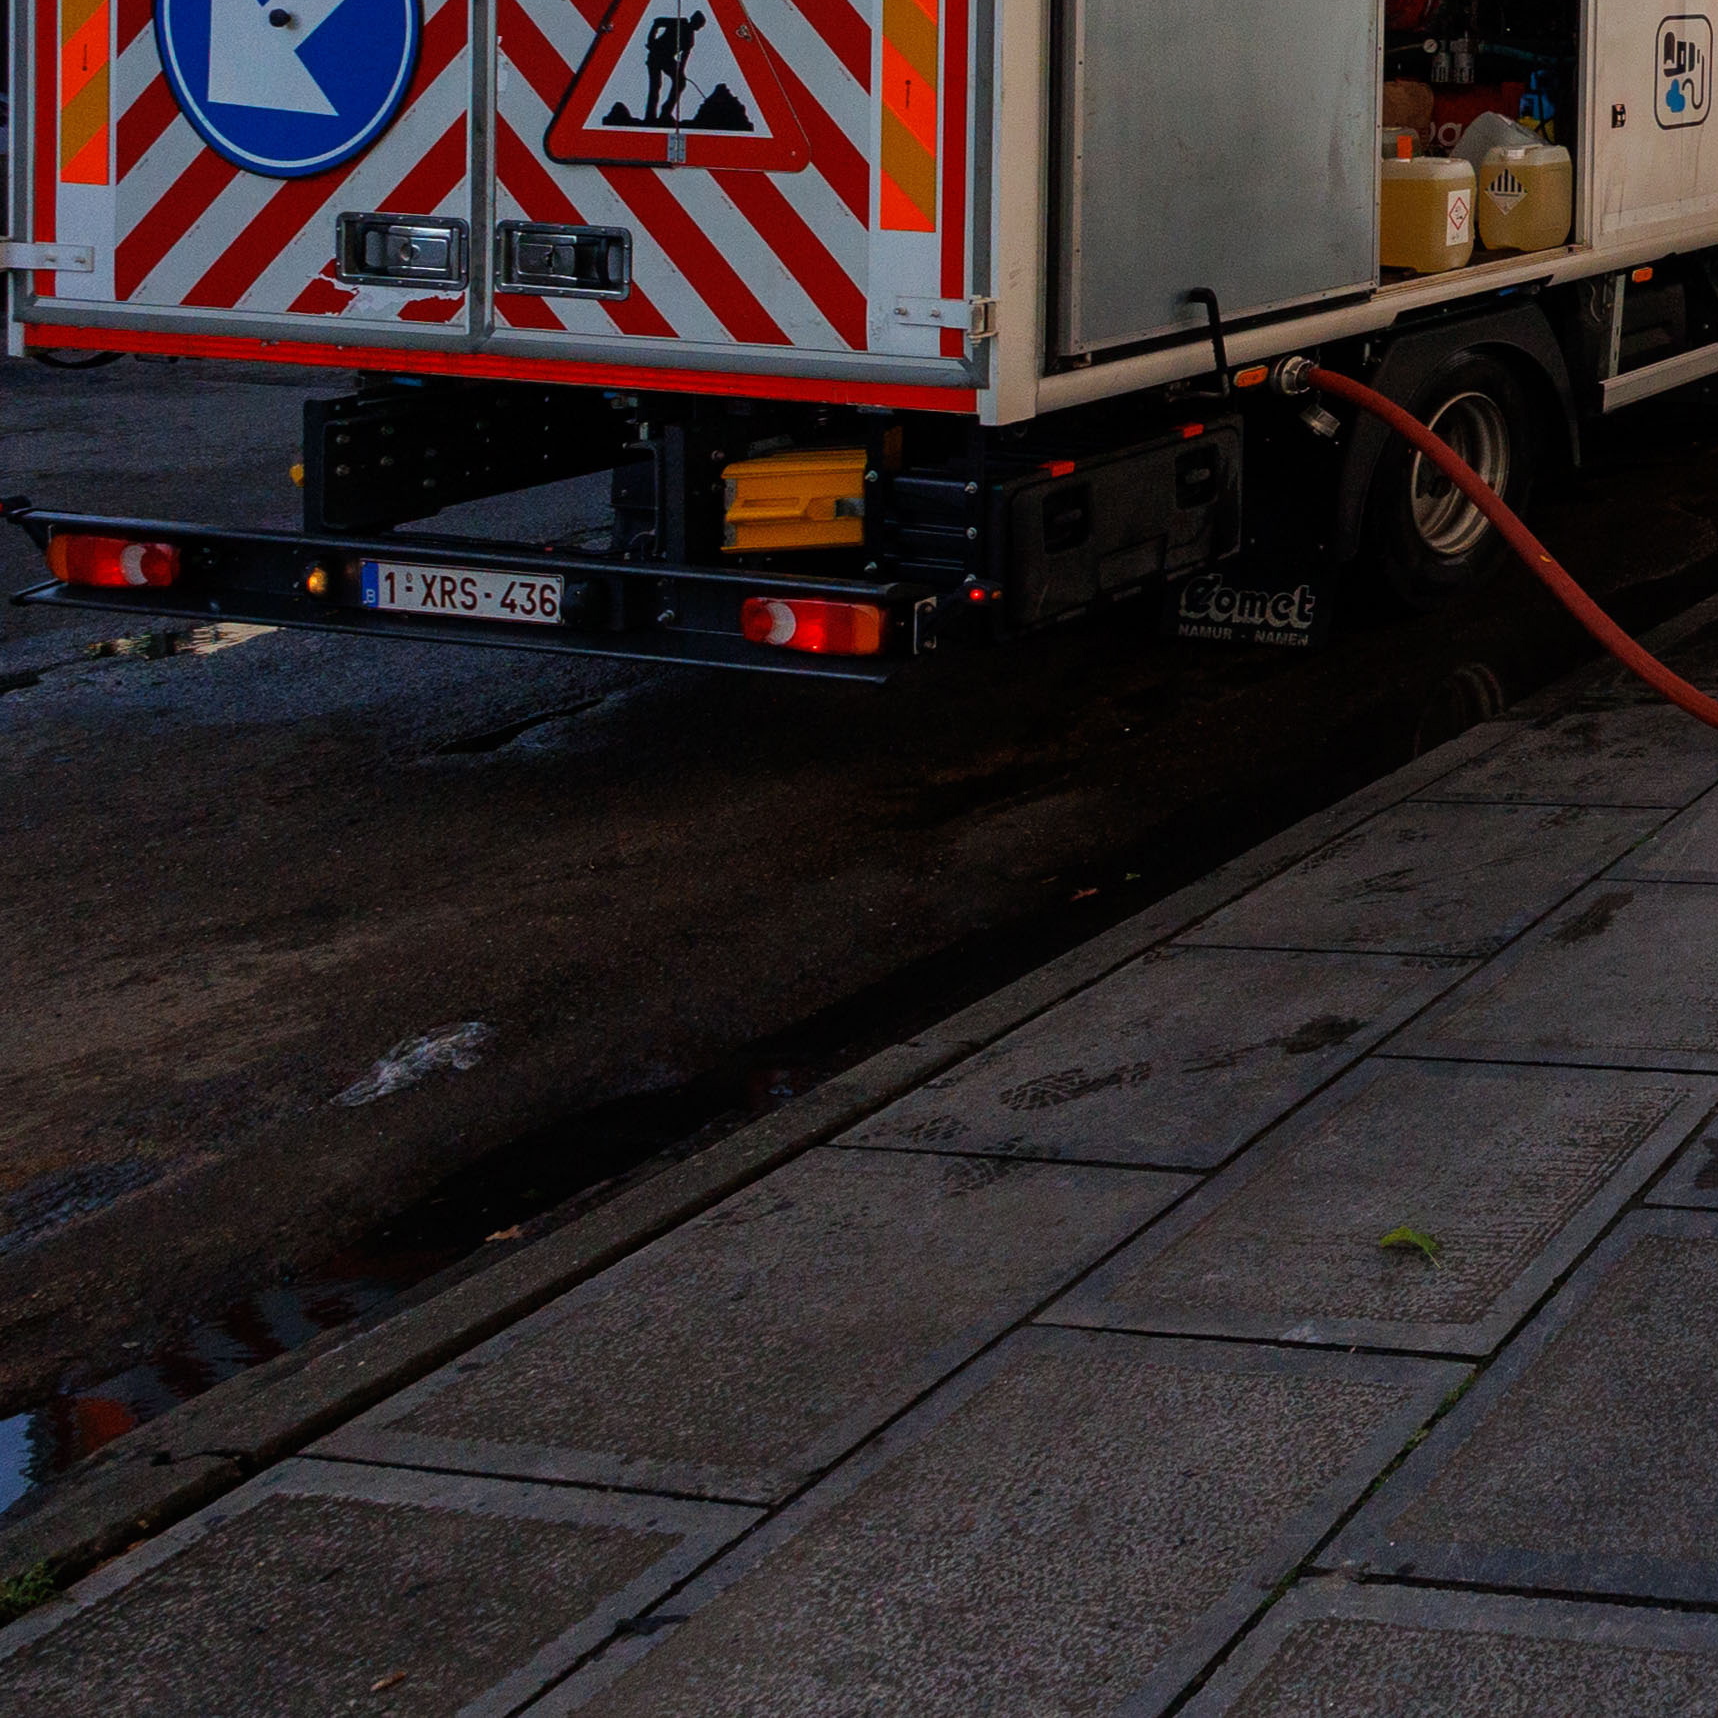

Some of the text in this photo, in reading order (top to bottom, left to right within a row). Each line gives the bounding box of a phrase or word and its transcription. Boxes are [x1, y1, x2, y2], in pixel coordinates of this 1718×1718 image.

[1178, 572, 1316, 630] Comet
[1178, 623, 1233, 641] NAMUR
[1254, 628, 1310, 647] NAMEN
